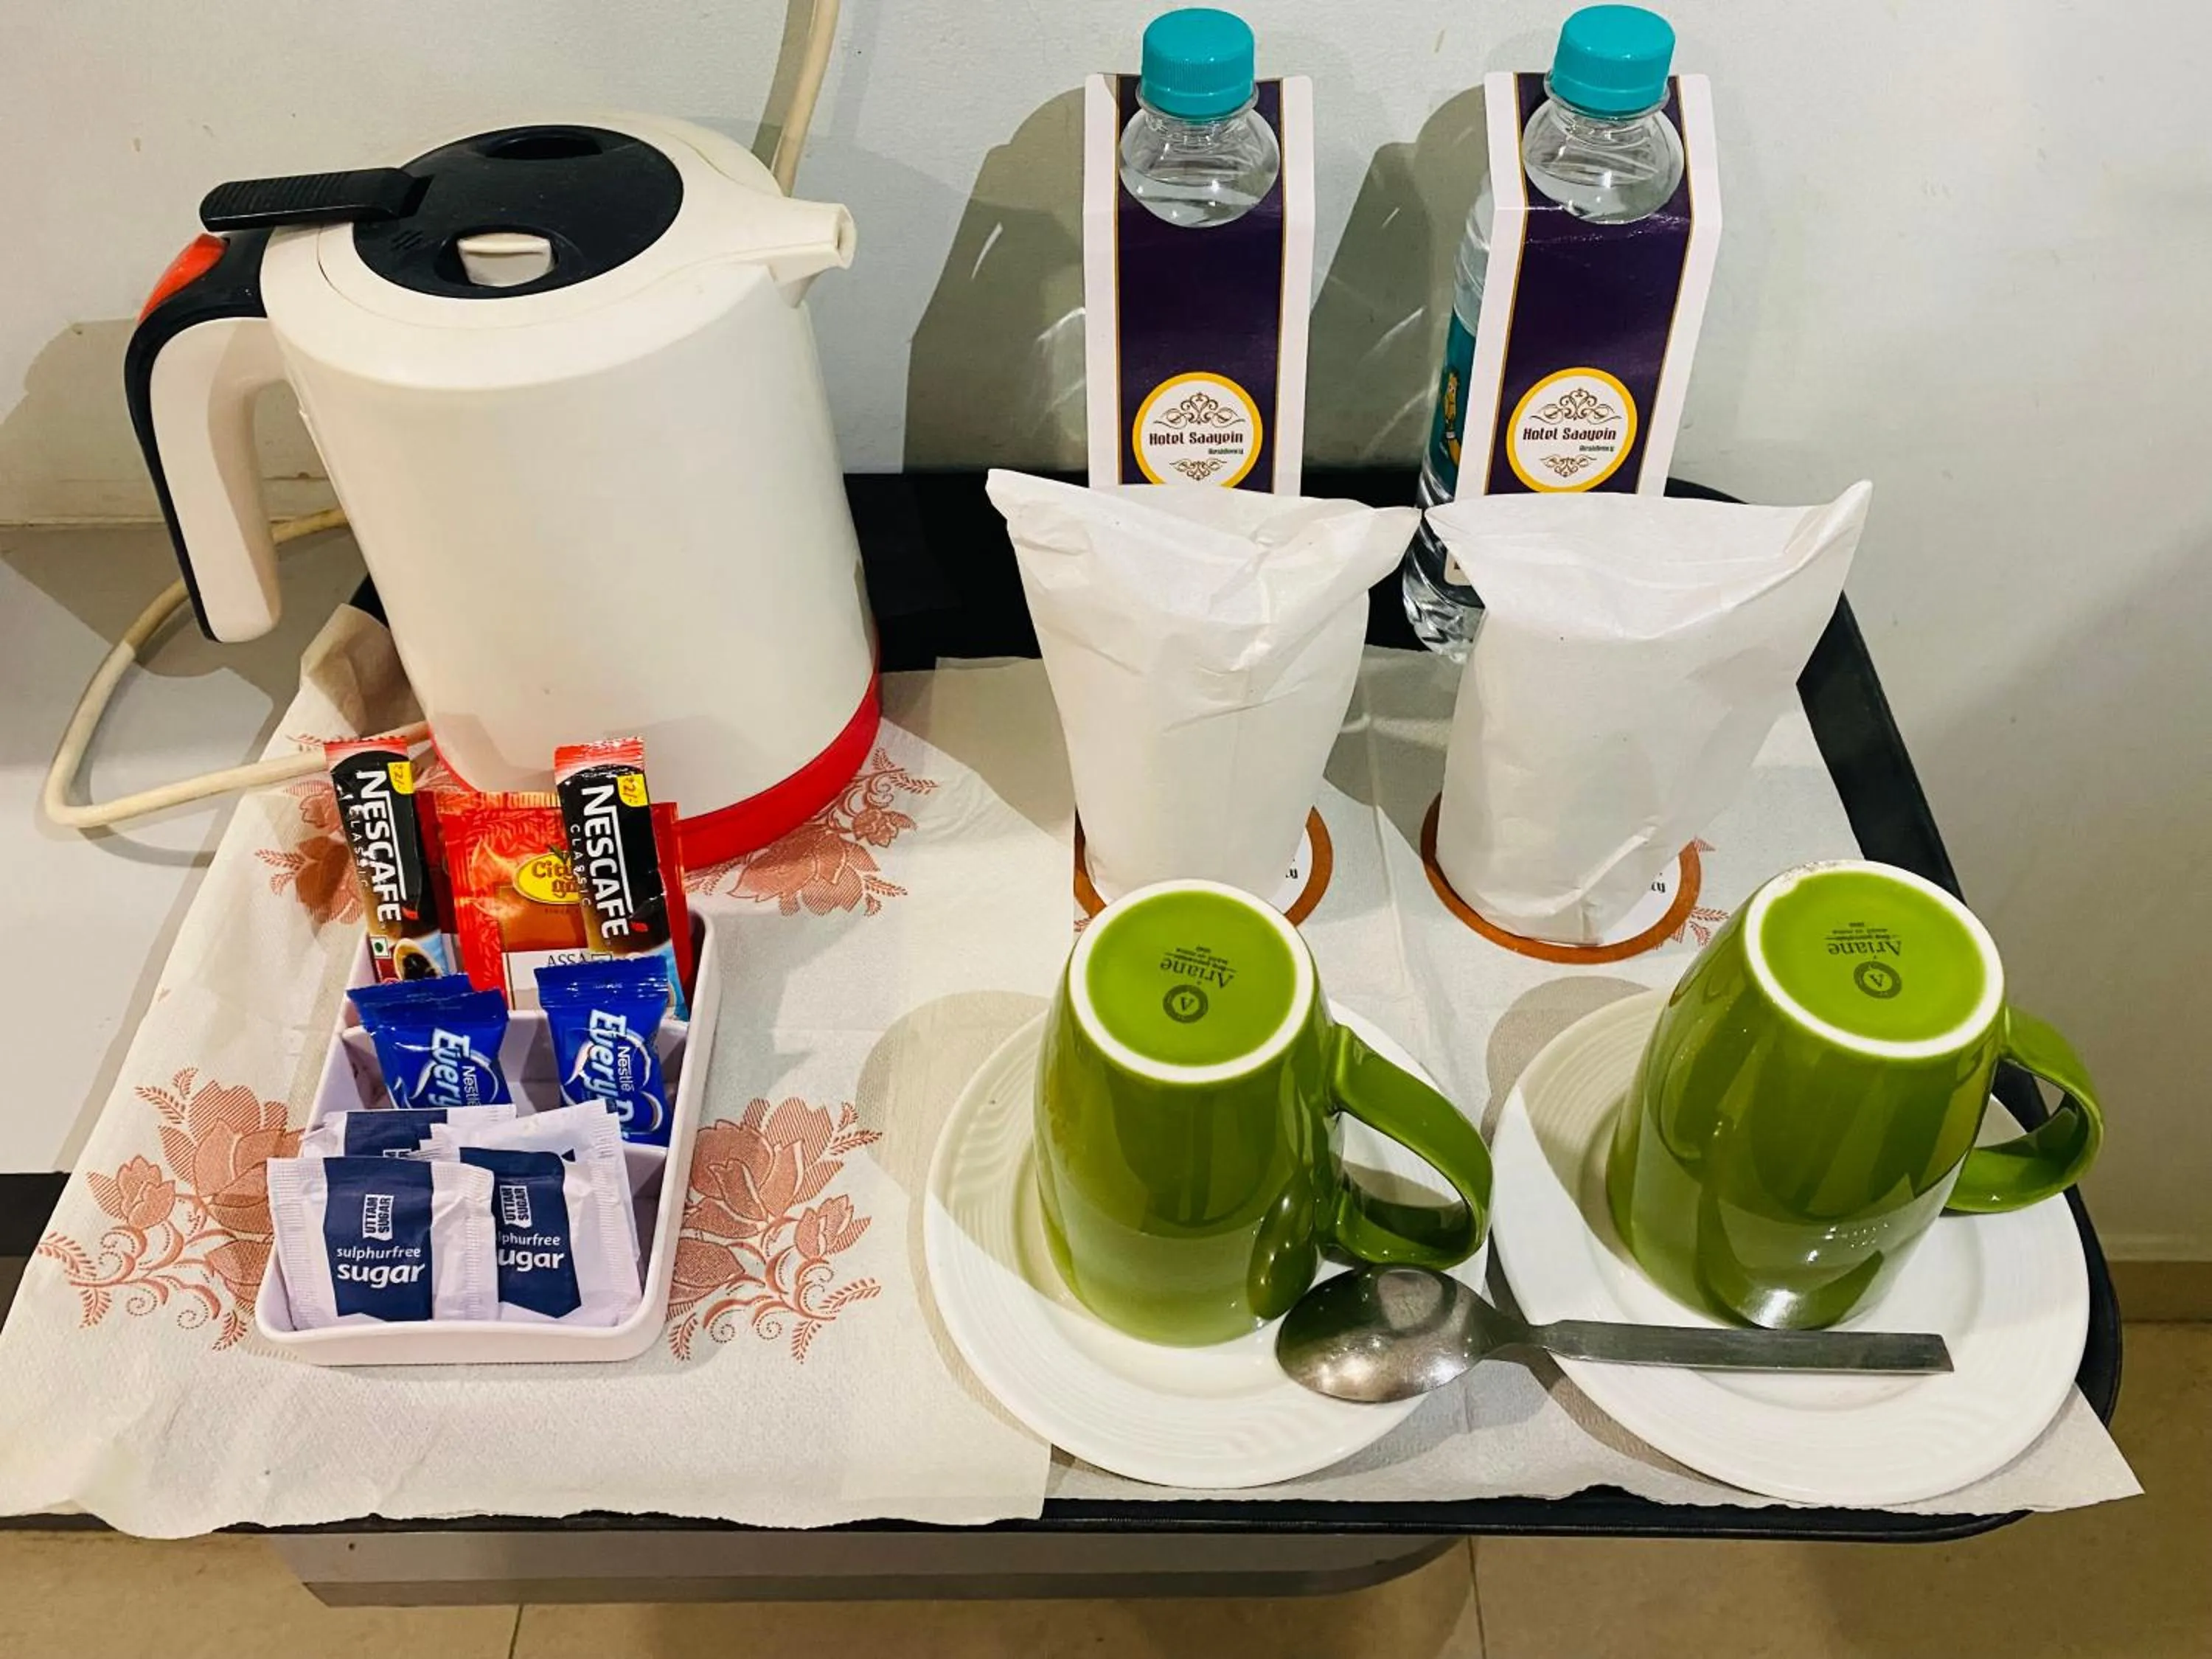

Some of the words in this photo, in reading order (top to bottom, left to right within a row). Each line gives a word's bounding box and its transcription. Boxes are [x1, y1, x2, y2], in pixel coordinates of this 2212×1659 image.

[1150, 432, 1184, 445] Hotel
[1523, 428, 1558, 440] Hotel
[548, 949, 588, 967] ASSA
[1828, 940, 1902, 959] Ariane
[1160, 957, 1234, 989] Ariane
[365, 1196, 378, 1234] UTTAM
[378, 1197, 392, 1234] SUGAR
[336, 1245, 422, 1262] sulphurfree
[498, 1248, 564, 1272] ugar
[337, 1263, 425, 1289] sugar
